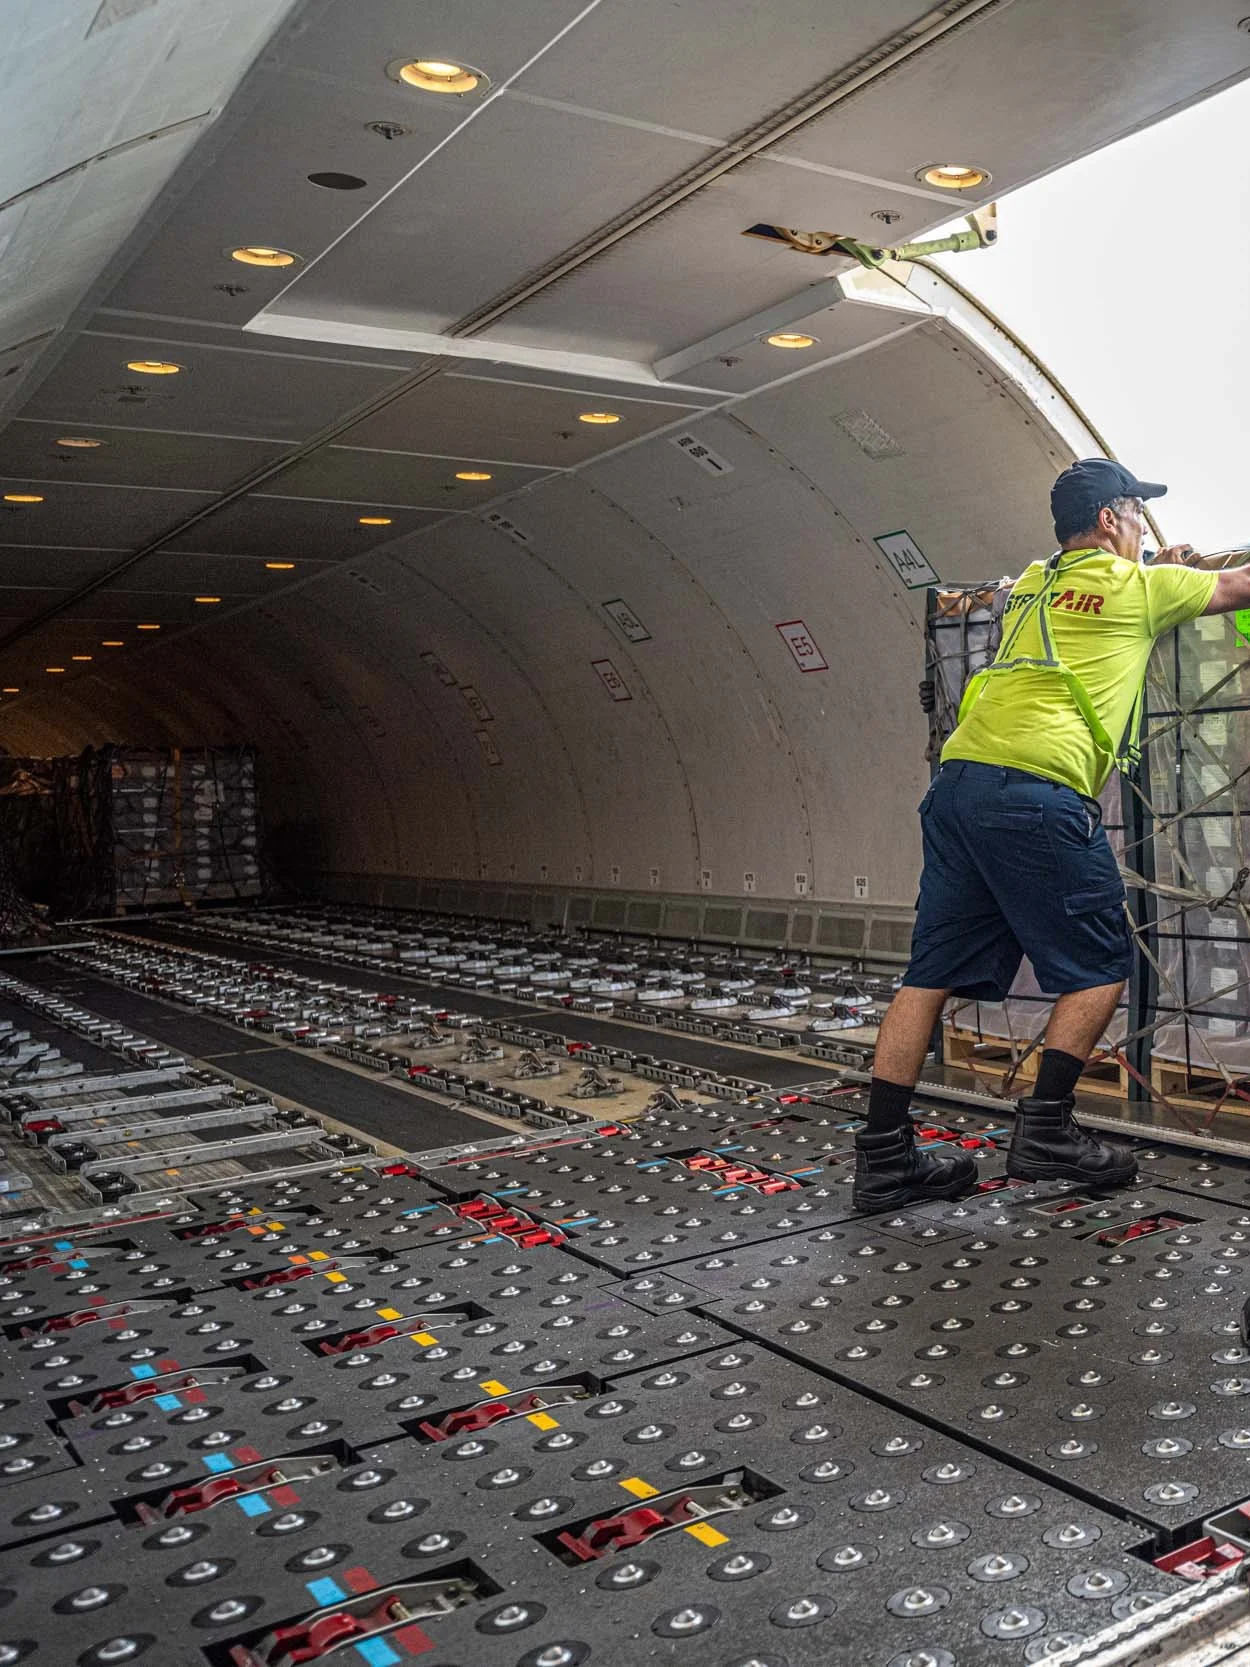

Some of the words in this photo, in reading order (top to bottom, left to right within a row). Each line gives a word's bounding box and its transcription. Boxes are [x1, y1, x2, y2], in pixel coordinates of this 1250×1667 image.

[893, 547, 926, 573] A4L
[1004, 590, 1105, 615] STRTAIR
[791, 636, 814, 656] E5
[856, 877, 866, 887] 625
